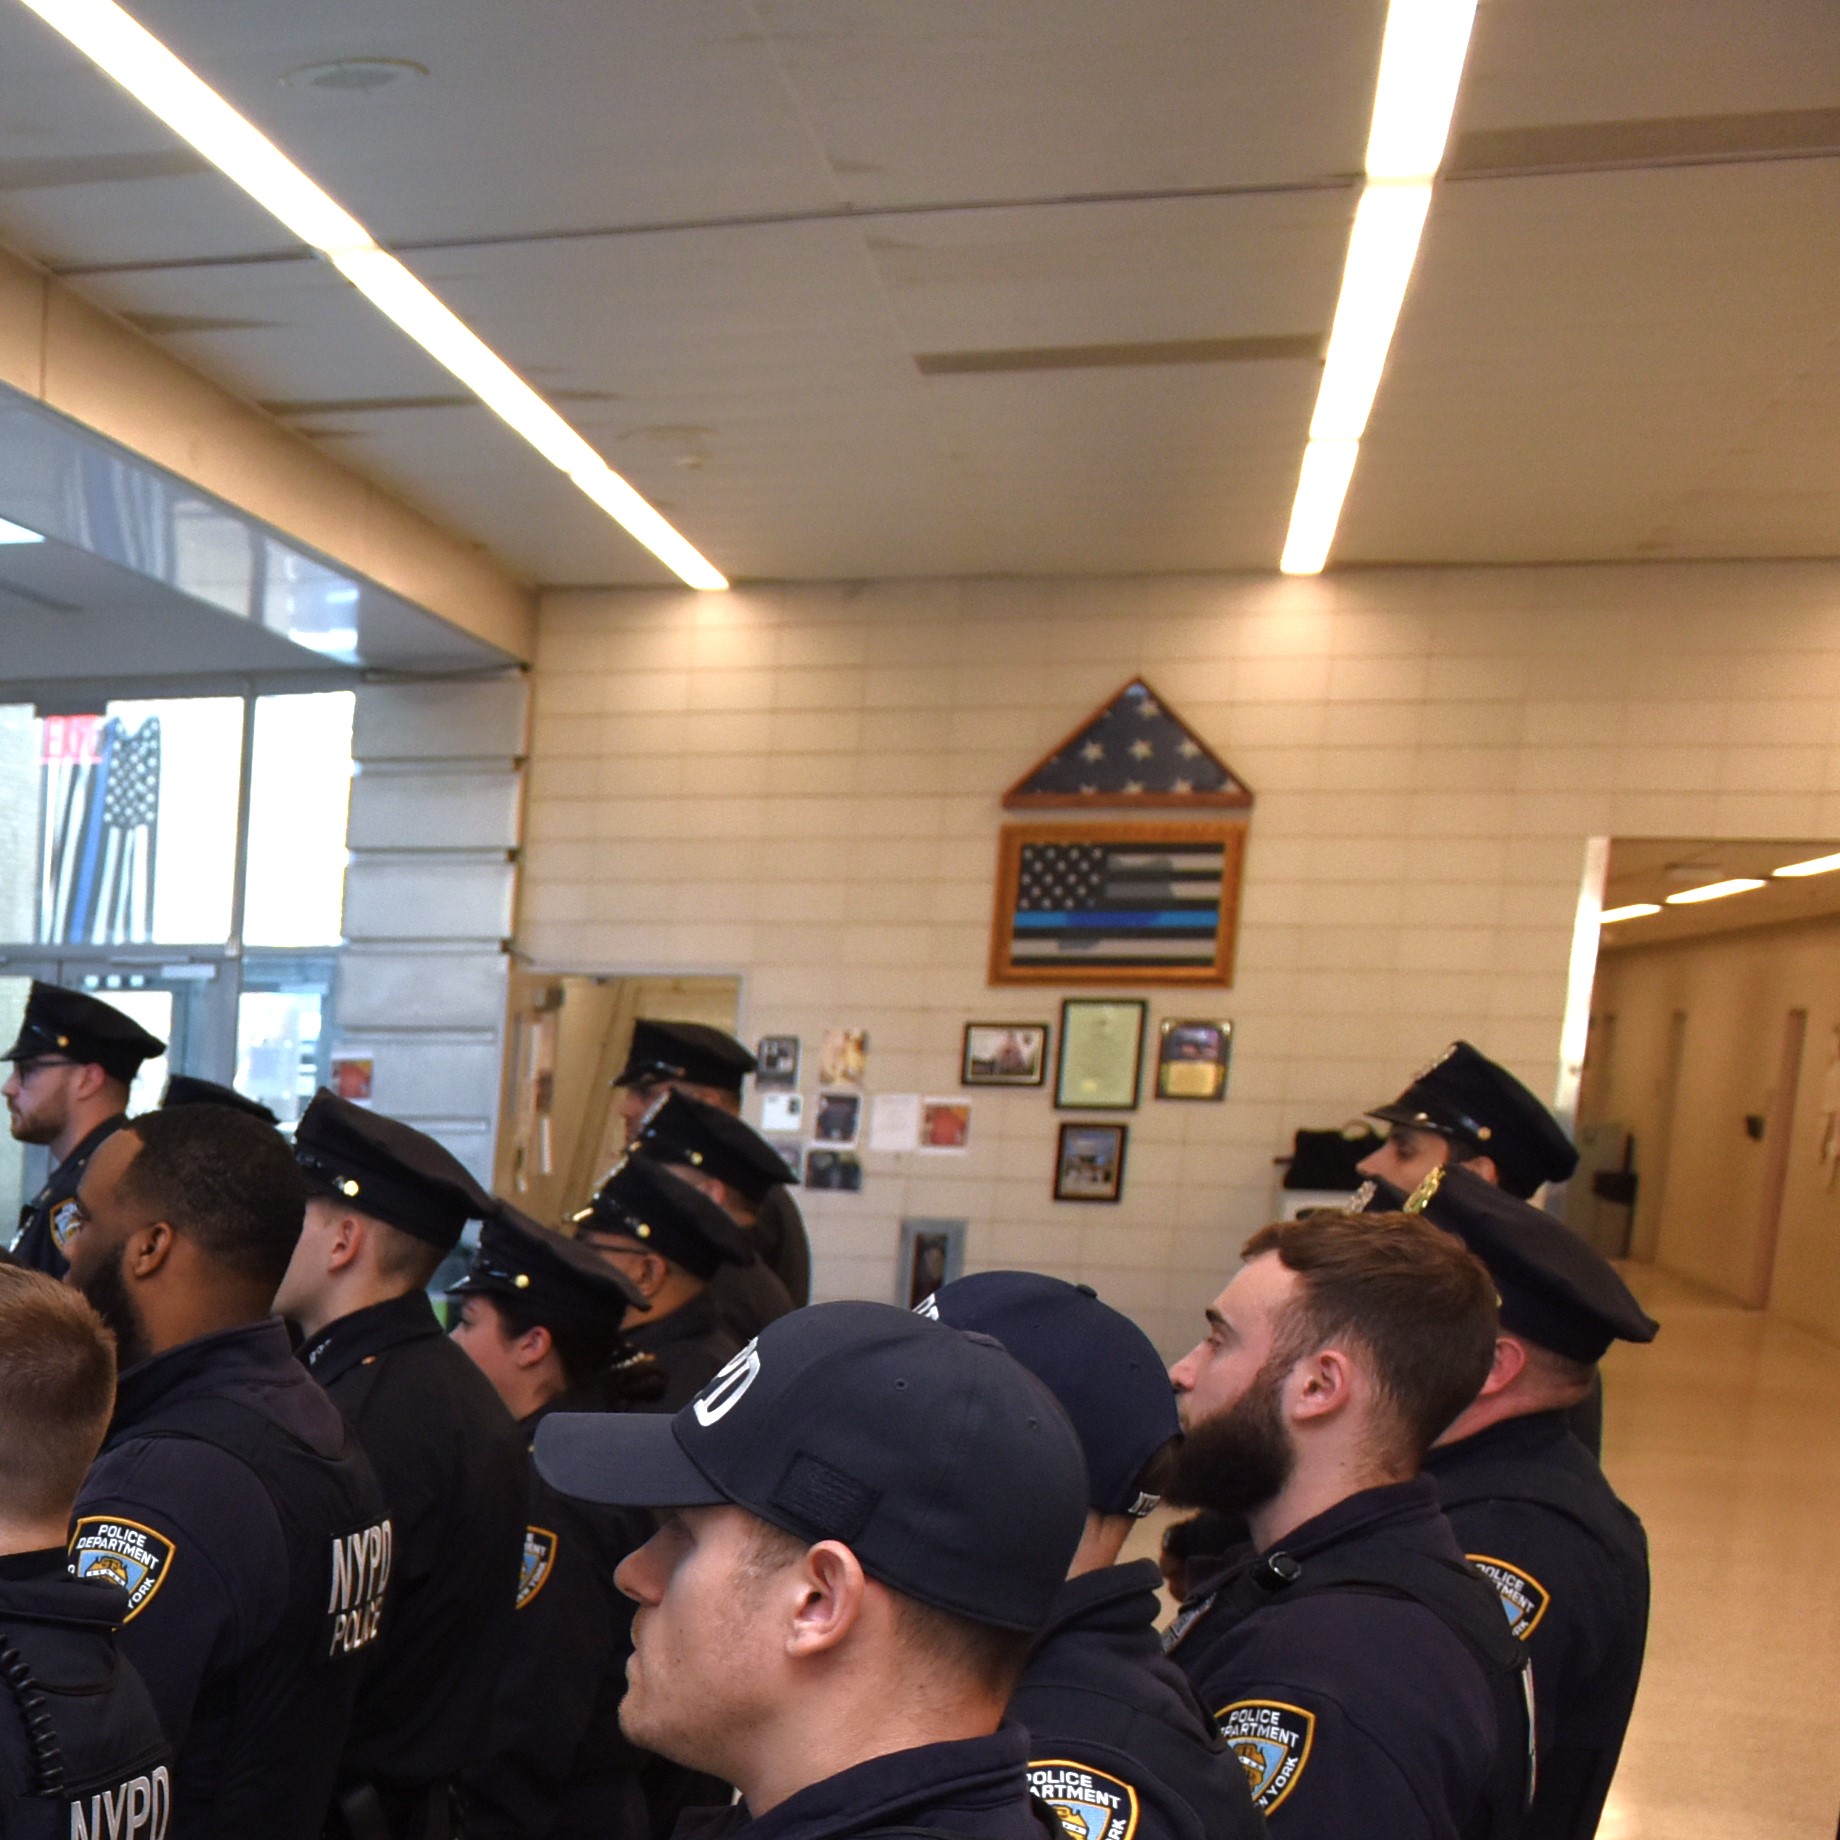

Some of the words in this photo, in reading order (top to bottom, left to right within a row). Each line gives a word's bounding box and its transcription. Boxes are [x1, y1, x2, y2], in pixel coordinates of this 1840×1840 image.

[97, 1524, 147, 1547] POLICE
[75, 1537, 160, 1569] DEPARTMENT
[328, 1518, 393, 1614] NYPD
[1228, 1708, 1280, 1726] POLICE
[1221, 1722, 1300, 1747] PARTMENT
[1267, 1756, 1299, 1796] YORK
[1030, 1784, 1121, 1809] ARTMENT
